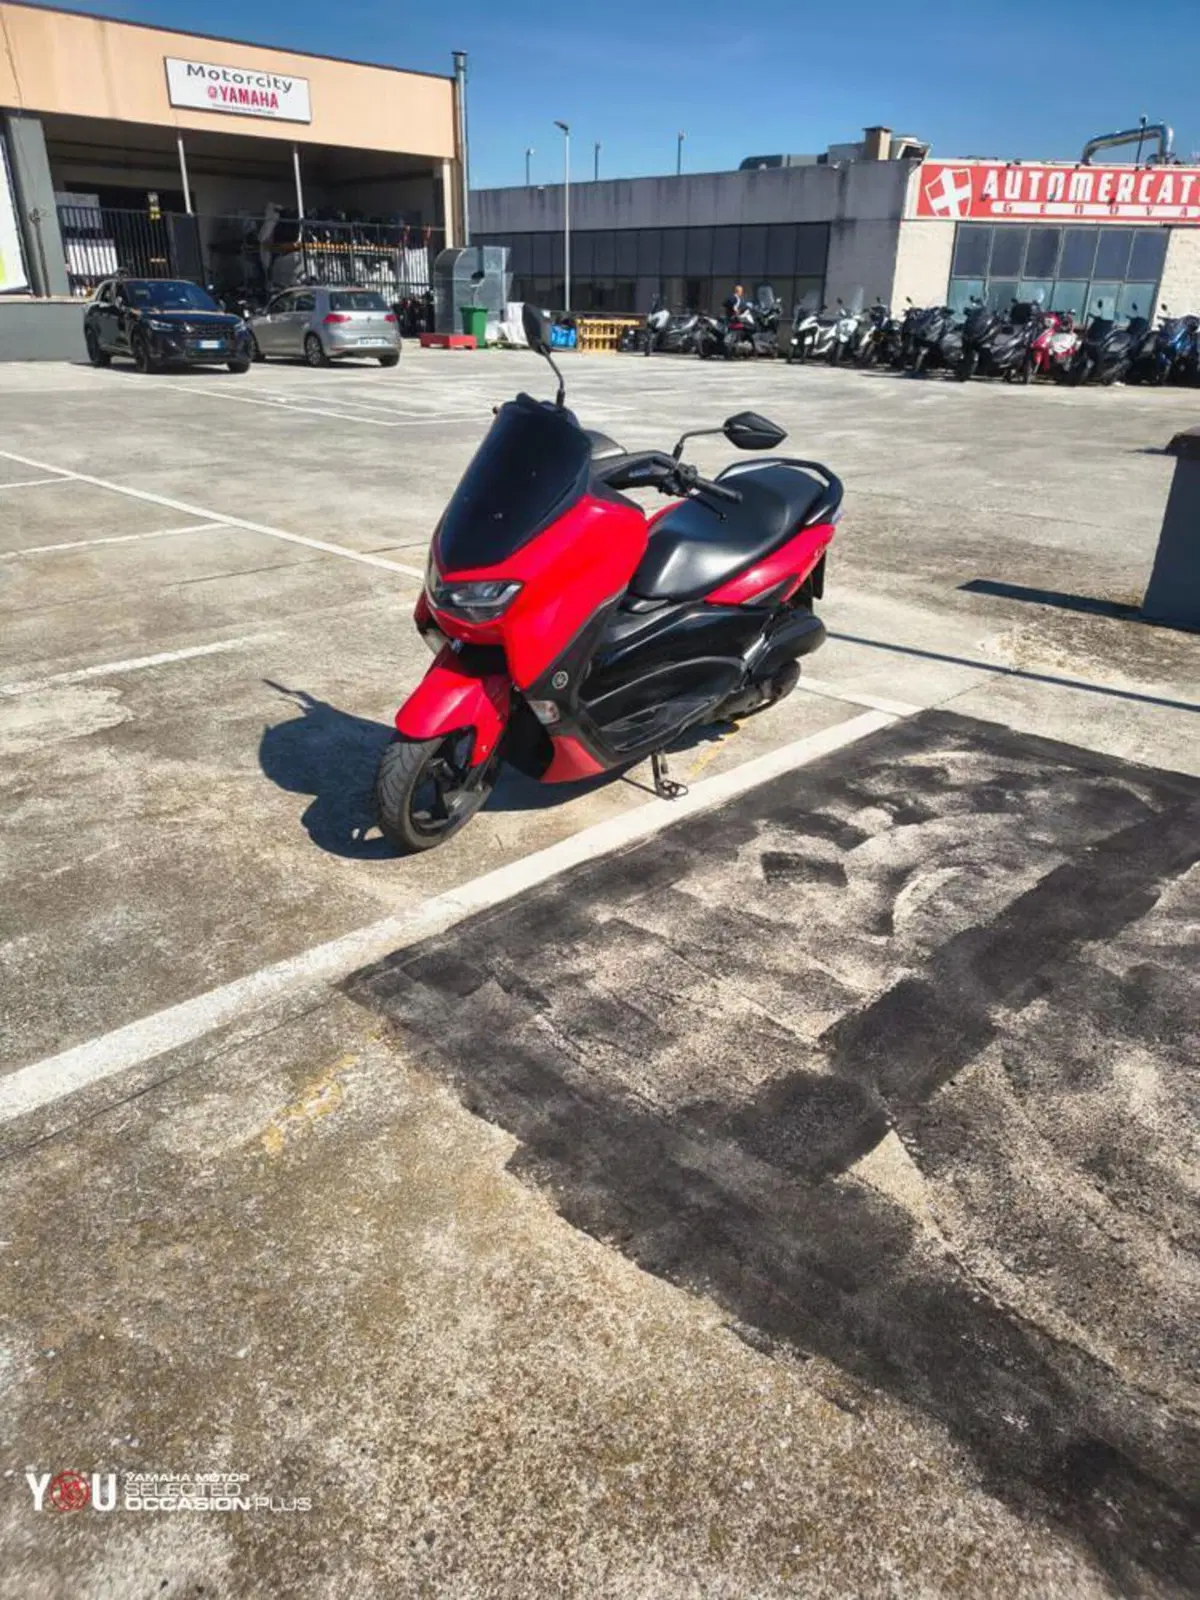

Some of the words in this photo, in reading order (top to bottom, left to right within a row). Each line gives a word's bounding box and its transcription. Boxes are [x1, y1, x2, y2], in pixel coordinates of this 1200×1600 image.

[186, 63, 293, 94] Motorcity
[219, 85, 279, 109] YAMAHA
[983, 169, 1200, 204] AUTOMERCAT
